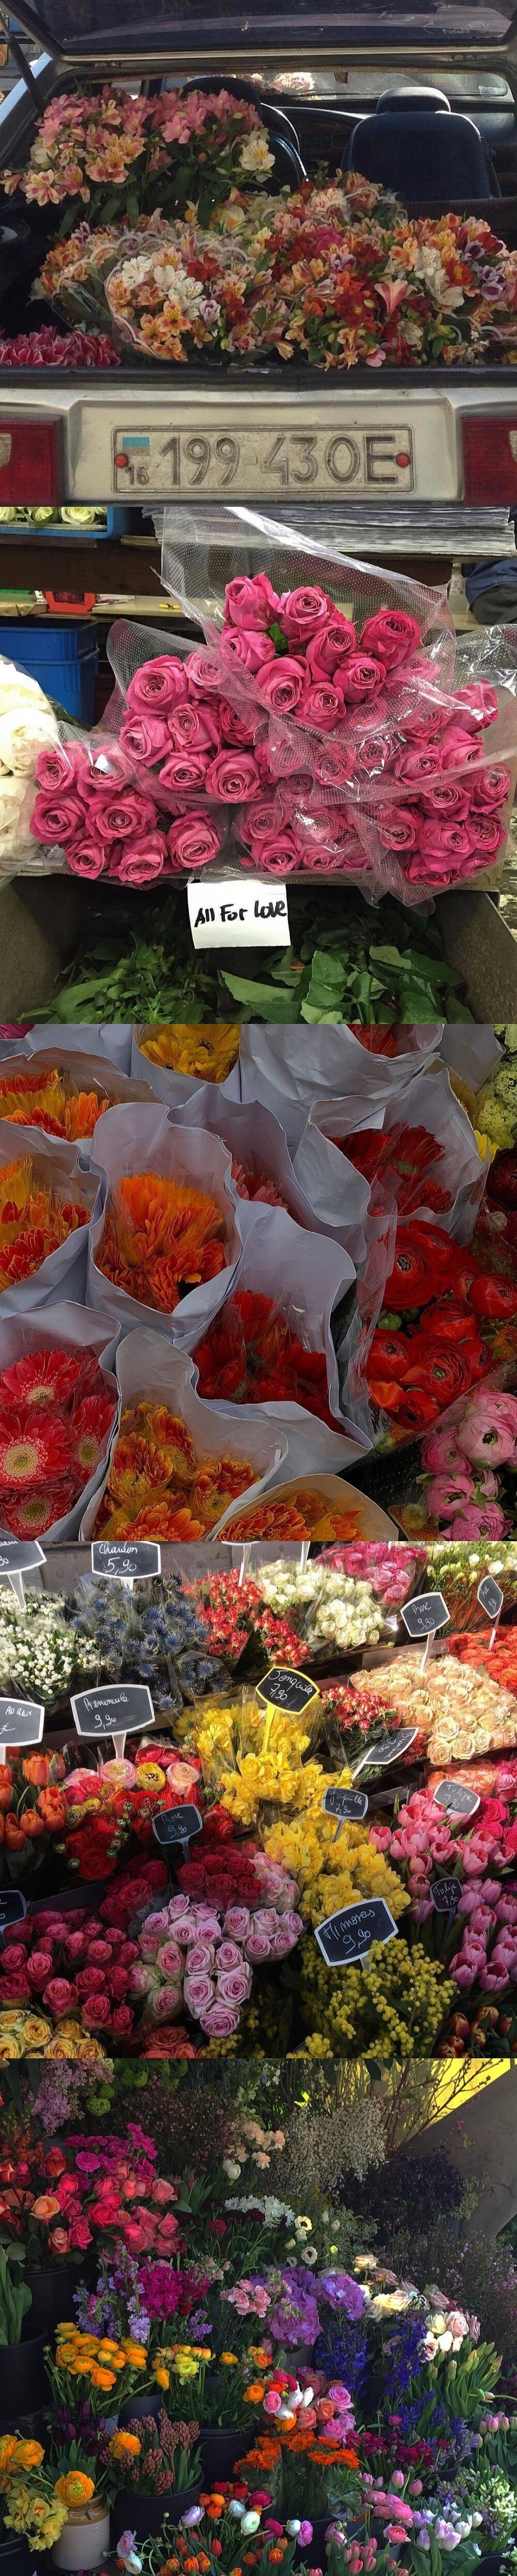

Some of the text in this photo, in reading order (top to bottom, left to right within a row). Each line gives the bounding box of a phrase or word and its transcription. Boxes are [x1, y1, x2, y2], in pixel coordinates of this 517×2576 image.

[126, 465, 149, 485] 16
[194, 900, 287, 927] All For Love
[104, 1557, 137, 1575] 5,90
[417, 1618, 434, 1631] 9,90
[269, 1683, 287, 1700] 7,90
[94, 1714, 116, 1730] 9,90
[336, 1803, 351, 1814] 7,90
